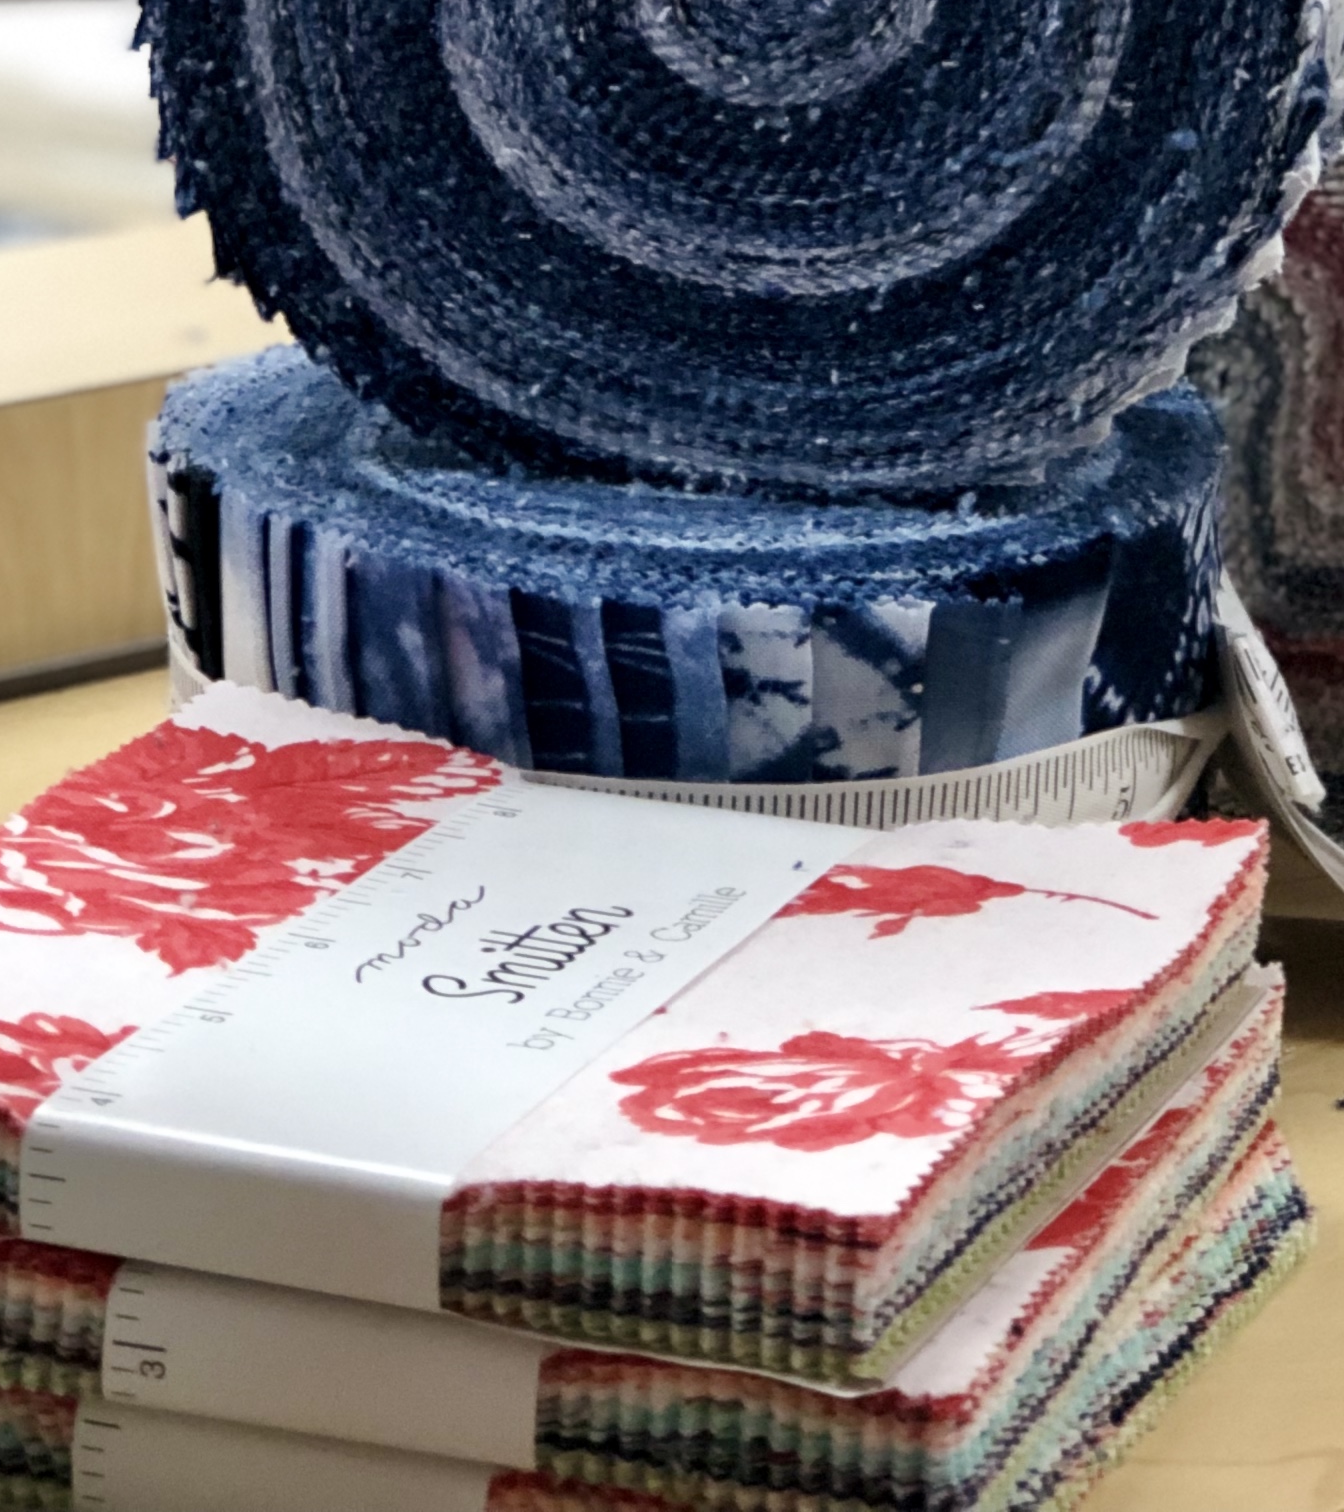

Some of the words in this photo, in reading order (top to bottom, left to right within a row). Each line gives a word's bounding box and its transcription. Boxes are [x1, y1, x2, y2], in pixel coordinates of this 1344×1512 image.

[356, 885, 485, 983] moda
[421, 905, 634, 1005] Smitten
[506, 1026, 574, 1051] by
[545, 965, 646, 1022] Bonnie
[624, 947, 666, 965] &
[649, 885, 748, 943] Camille
[139, 1359, 168, 1380] 3
